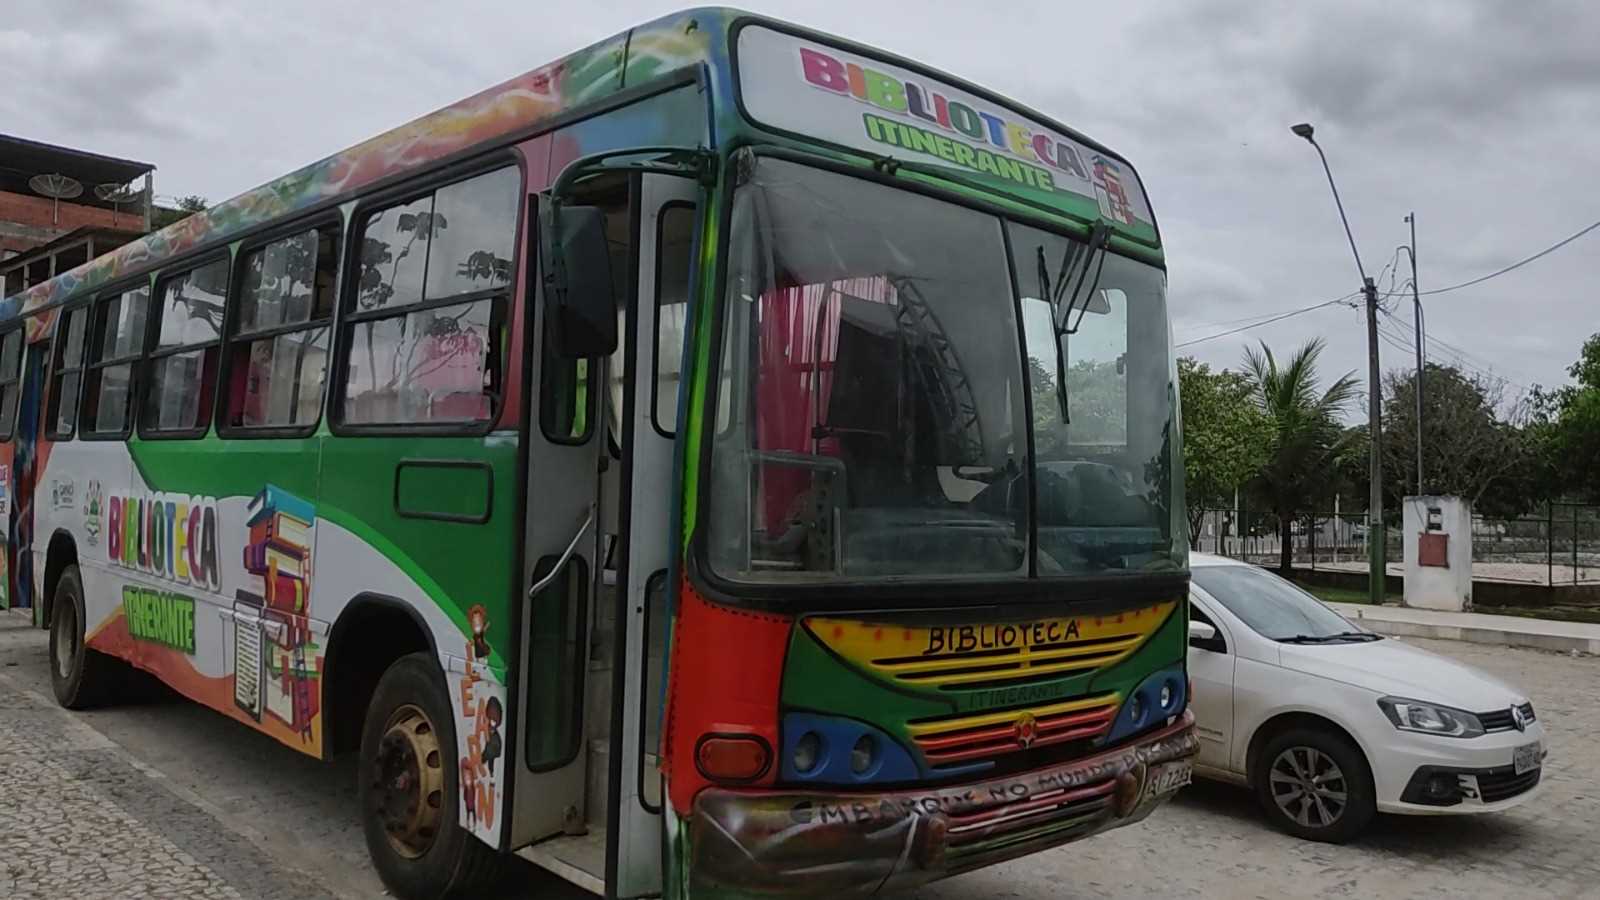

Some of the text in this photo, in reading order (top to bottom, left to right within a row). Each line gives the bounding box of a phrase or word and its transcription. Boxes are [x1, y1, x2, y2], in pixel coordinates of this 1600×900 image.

[800, 47, 1089, 180] BIBLIOTECA
[864, 113, 1054, 191] ITINERANTE
[107, 491, 221, 590] BIBLIOTECA
[122, 585, 196, 656] ITINERANTE
[923, 619, 1080, 655] BIBLIOTECA
[969, 683, 1063, 708] ITINERANTE
[989, 783, 1028, 802] NO
